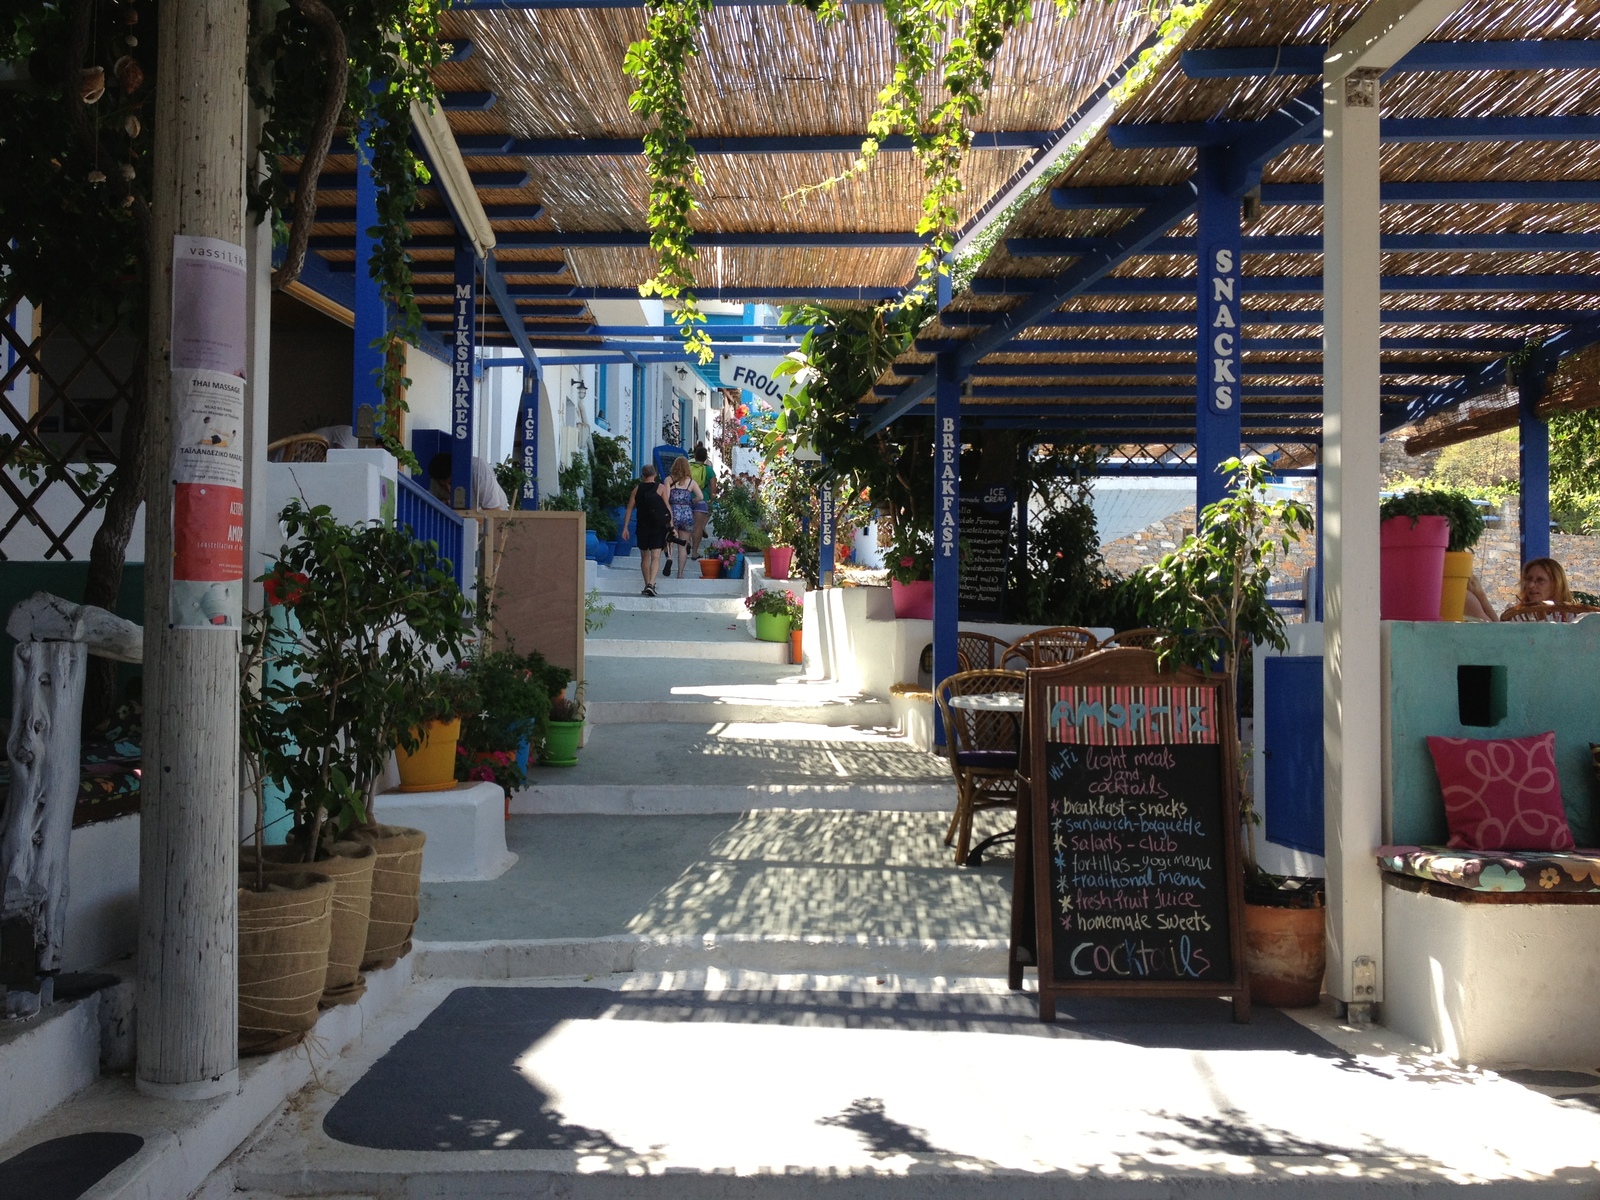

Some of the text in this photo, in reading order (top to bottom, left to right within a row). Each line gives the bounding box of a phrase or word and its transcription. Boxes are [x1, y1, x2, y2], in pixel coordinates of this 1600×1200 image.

[1212, 249, 1236, 409] SNACKS
[455, 284, 471, 440] MILKSHAKES
[192, 380, 241, 394] THAI MASSAGE
[524, 408, 534, 499] ICE CREAM
[941, 418, 955, 557] BREAKFAST
[989, 488, 1005, 496] ICE
[983, 495, 1007, 503] CREAM
[822, 480, 832, 546] CREPES
[975, 516, 1000, 526] Ferrero
[1086, 747, 1176, 781] light meals
[1114, 768, 1140, 781] and
[1088, 775, 1168, 799] cocktails
[1139, 835, 1178, 852] club
[1174, 855, 1212, 870] menu
[1072, 867, 1206, 889] traditional menu
[1076, 888, 1112, 910] fresh
[1113, 888, 1149, 909] fruit
[1077, 913, 1152, 932] homemade
